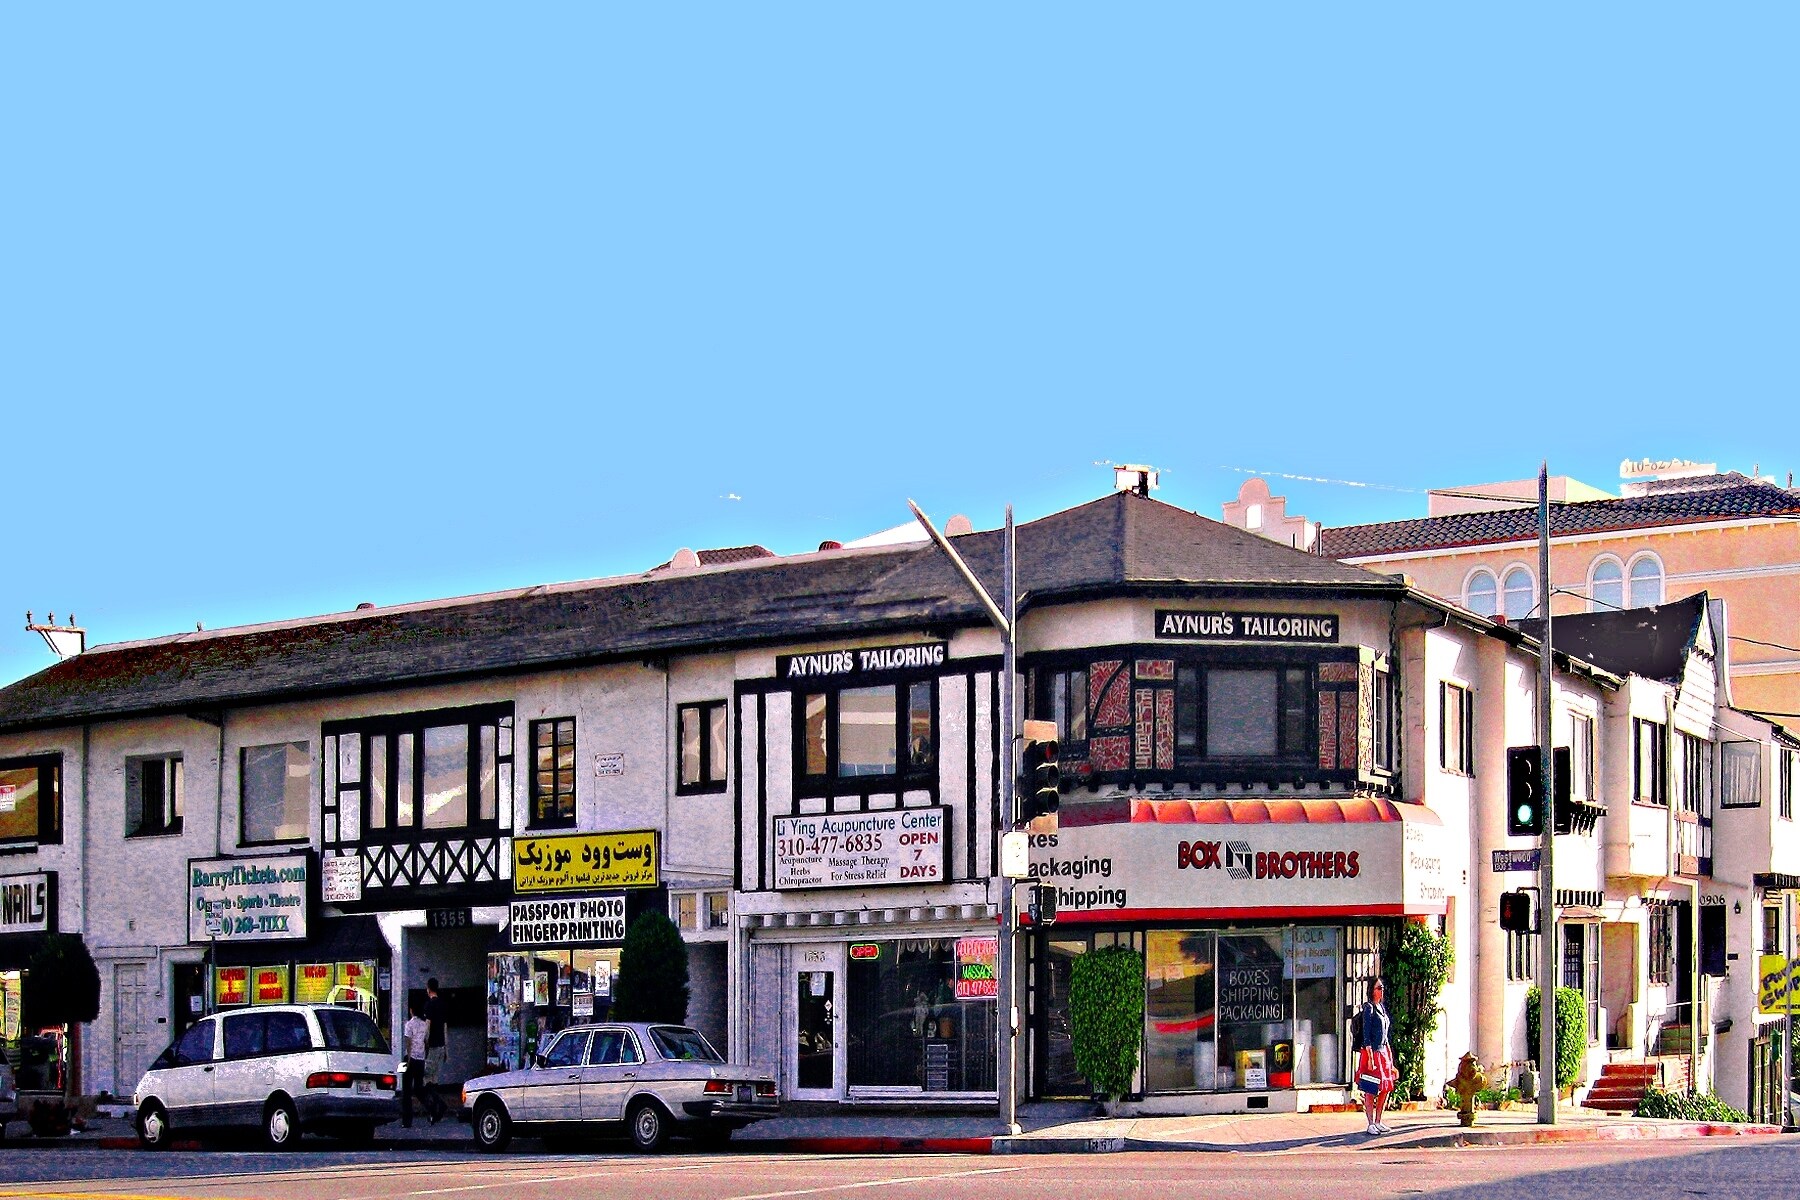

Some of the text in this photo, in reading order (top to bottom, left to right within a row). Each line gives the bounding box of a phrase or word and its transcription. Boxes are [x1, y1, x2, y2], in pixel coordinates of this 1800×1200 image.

[1162, 612, 1332, 638] AYNUR'S TAILORING
[789, 645, 944, 677] AYNUR'S TAILORING
[791, 819, 816, 838] Ying
[821, 816, 896, 836] Acupuncture
[901, 812, 942, 829] Center
[778, 833, 882, 857] 310-477-6835
[899, 832, 939, 846] OPEN
[1028, 833, 1059, 848] xes
[779, 856, 823, 866] Acupuncture
[828, 855, 890, 869] Massage Therapy
[914, 849, 923, 862] 7
[1178, 840, 1360, 879] BOX BROTHERS
[790, 867, 811, 875] Herbs
[831, 869, 887, 880] For Stress Relief
[900, 865, 937, 878] DAYS
[1028, 856, 1112, 879] ackaging
[779, 876, 822, 887] Chiropractor
[3, 883, 45, 924] NAILS
[269, 893, 301, 907] Theatre
[1057, 885, 1126, 909] hipping
[512, 899, 624, 922] PASSPORT PHOTO
[433, 911, 465, 927] 1355
[513, 920, 625, 942] FINGERPRINTING
[1230, 970, 1270, 986] BOXES
[1221, 987, 1279, 1003] SHIPPING
[1219, 1004, 1281, 1021] PACKAGING
